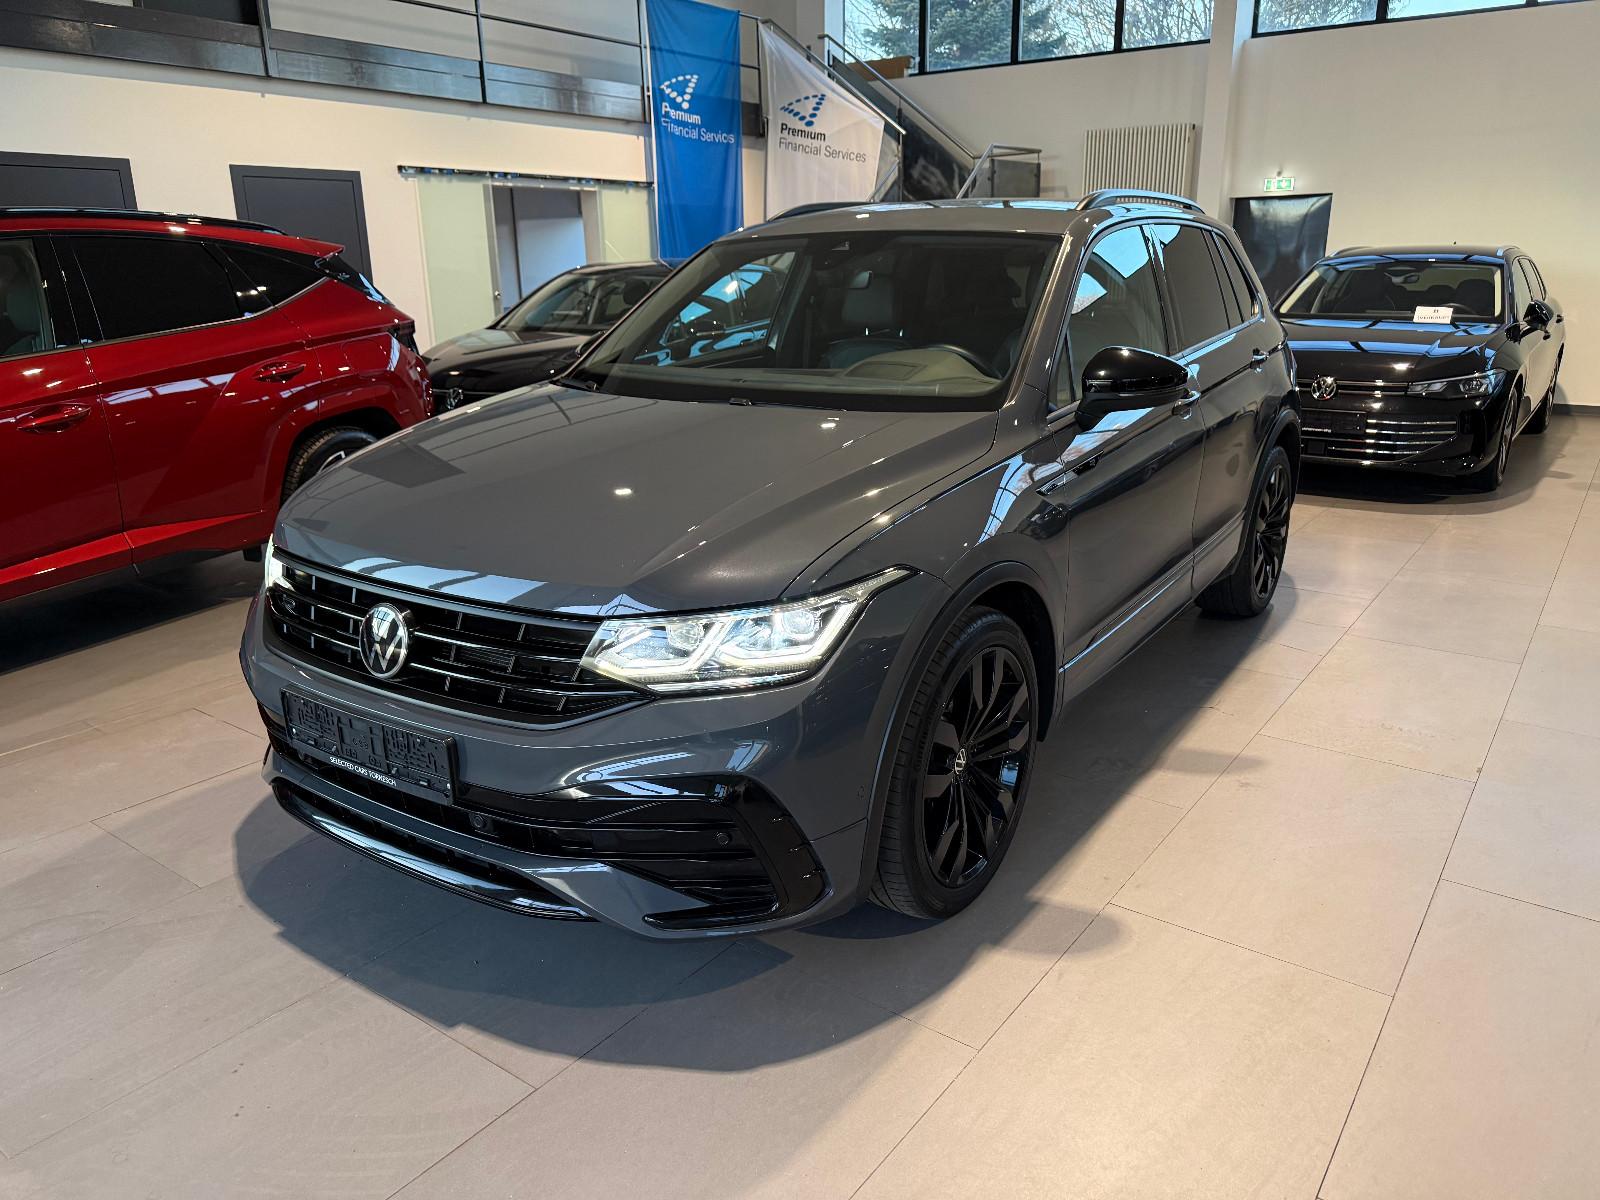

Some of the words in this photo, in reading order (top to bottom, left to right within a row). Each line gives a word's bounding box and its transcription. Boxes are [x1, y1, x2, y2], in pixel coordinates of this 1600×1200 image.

[662, 102, 701, 125] Pemium
[780, 122, 826, 142] Premium
[778, 136, 822, 157] Financial
[824, 144, 867, 163] Services
[329, 756, 354, 770] SELECTED
[354, 765, 368, 776] CARS
